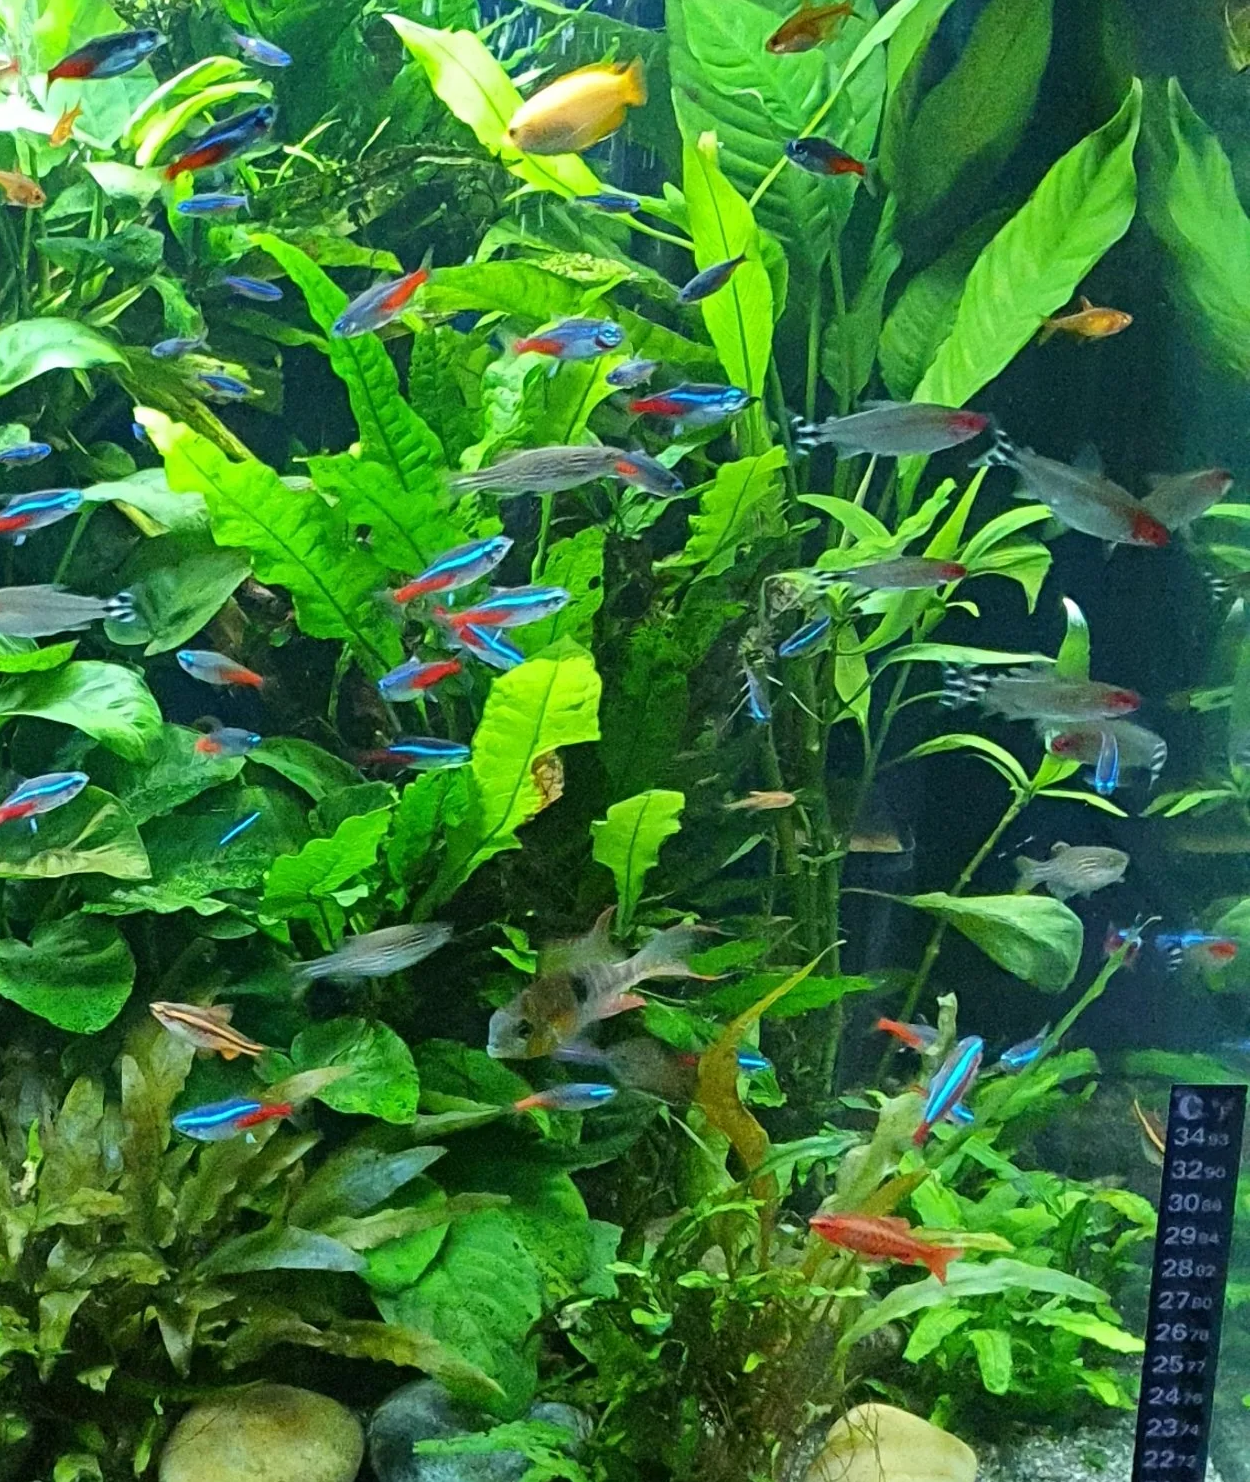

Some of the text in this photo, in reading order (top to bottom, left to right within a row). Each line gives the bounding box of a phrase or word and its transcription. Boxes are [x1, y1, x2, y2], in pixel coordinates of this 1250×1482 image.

[1174, 1127, 1204, 1147] 34
[1172, 1160, 1226, 1179] 32 90
[1168, 1194, 1199, 1212] 30
[1165, 1227, 1197, 1245] 29
[1162, 1259, 1193, 1278] 28
[1158, 1291, 1190, 1310] 27
[1154, 1323, 1187, 1341] 26
[1152, 1355, 1205, 1373] 25 77
[1148, 1387, 1180, 1404] 24
[1145, 1418, 1178, 1437] 23
[1142, 1450, 1197, 1468] 22 72
